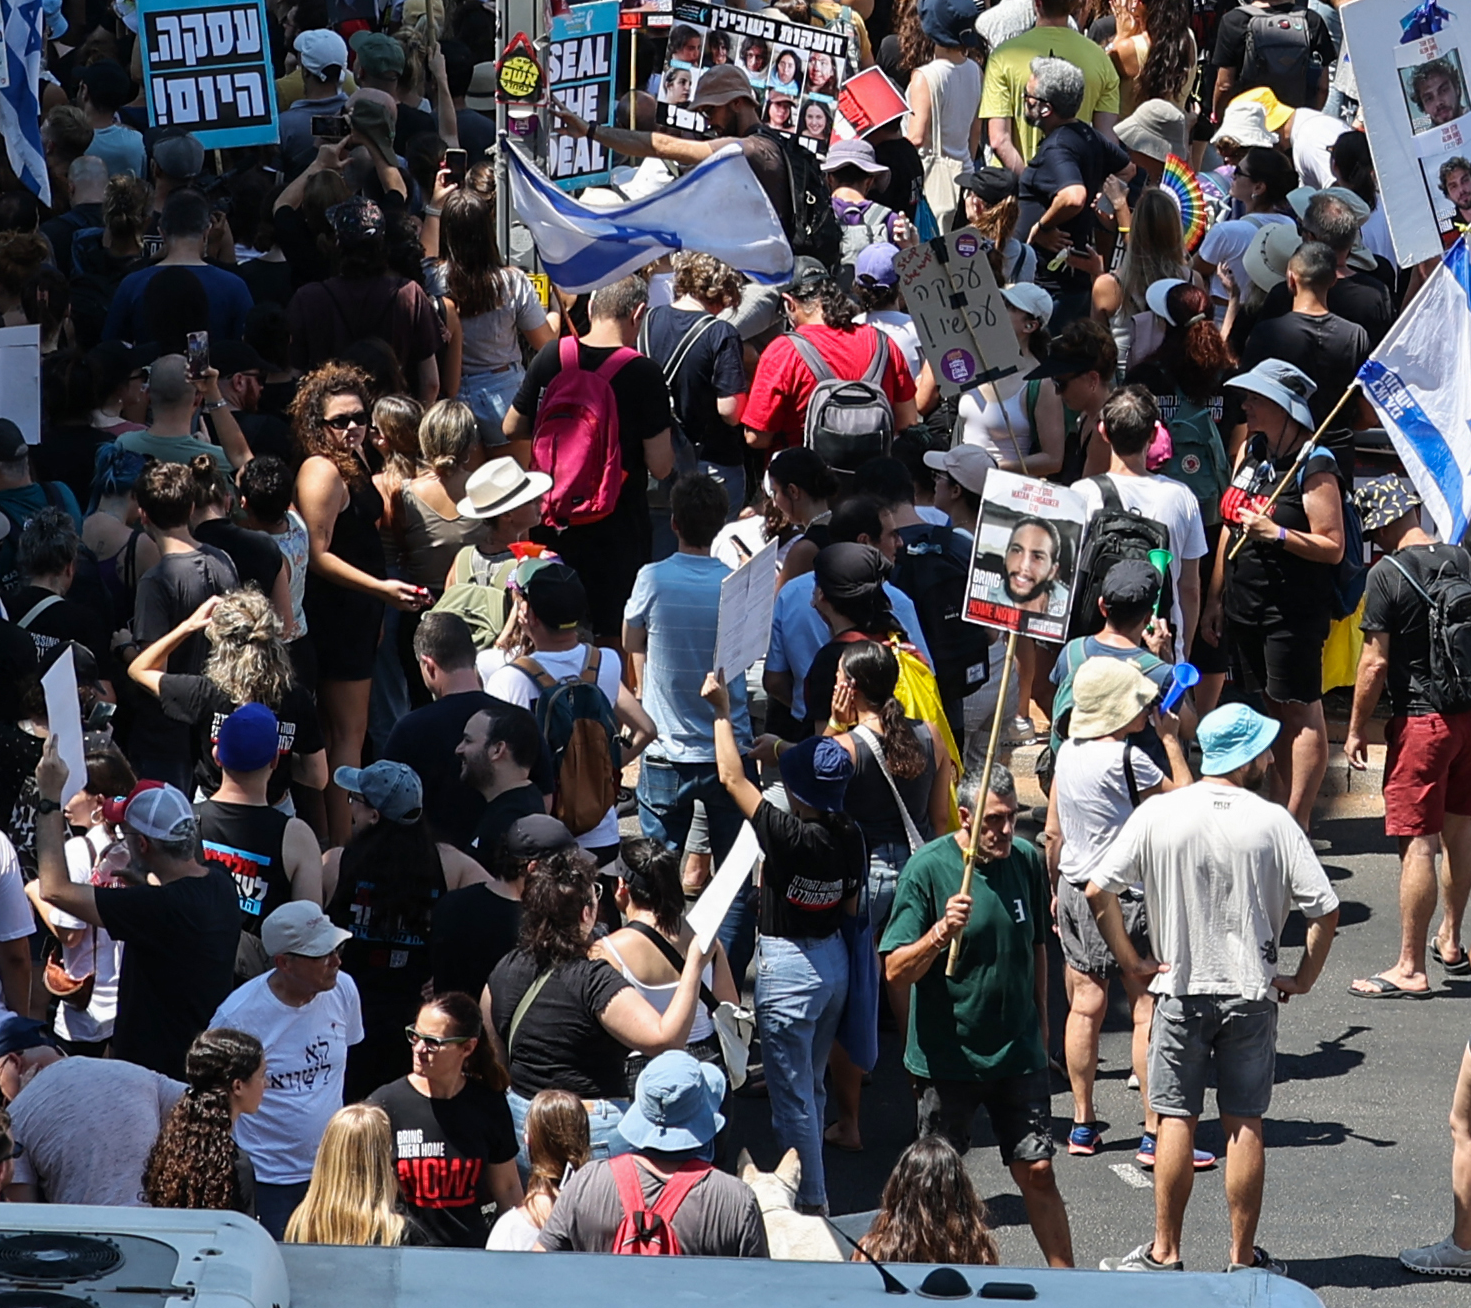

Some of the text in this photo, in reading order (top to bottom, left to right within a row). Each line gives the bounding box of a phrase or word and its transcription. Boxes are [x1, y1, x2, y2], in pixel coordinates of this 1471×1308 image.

[149, 7, 263, 68] עסקה.
[709, 6, 845, 56] זועקות בשבילן
[548, 34, 610, 84] SEAL
[500, 65, 539, 88] אשם
[151, 71, 266, 127] היום!
[550, 82, 599, 130] THE
[968, 583, 990, 603] HIM
[972, 567, 1001, 590] BRING
[967, 600, 994, 621] HOME
[304, 1034, 330, 1065] לא
[396, 1128, 424, 1145] BRING
[396, 1140, 446, 1160] THEM HOME
[396, 1157, 483, 1202] NOW!
